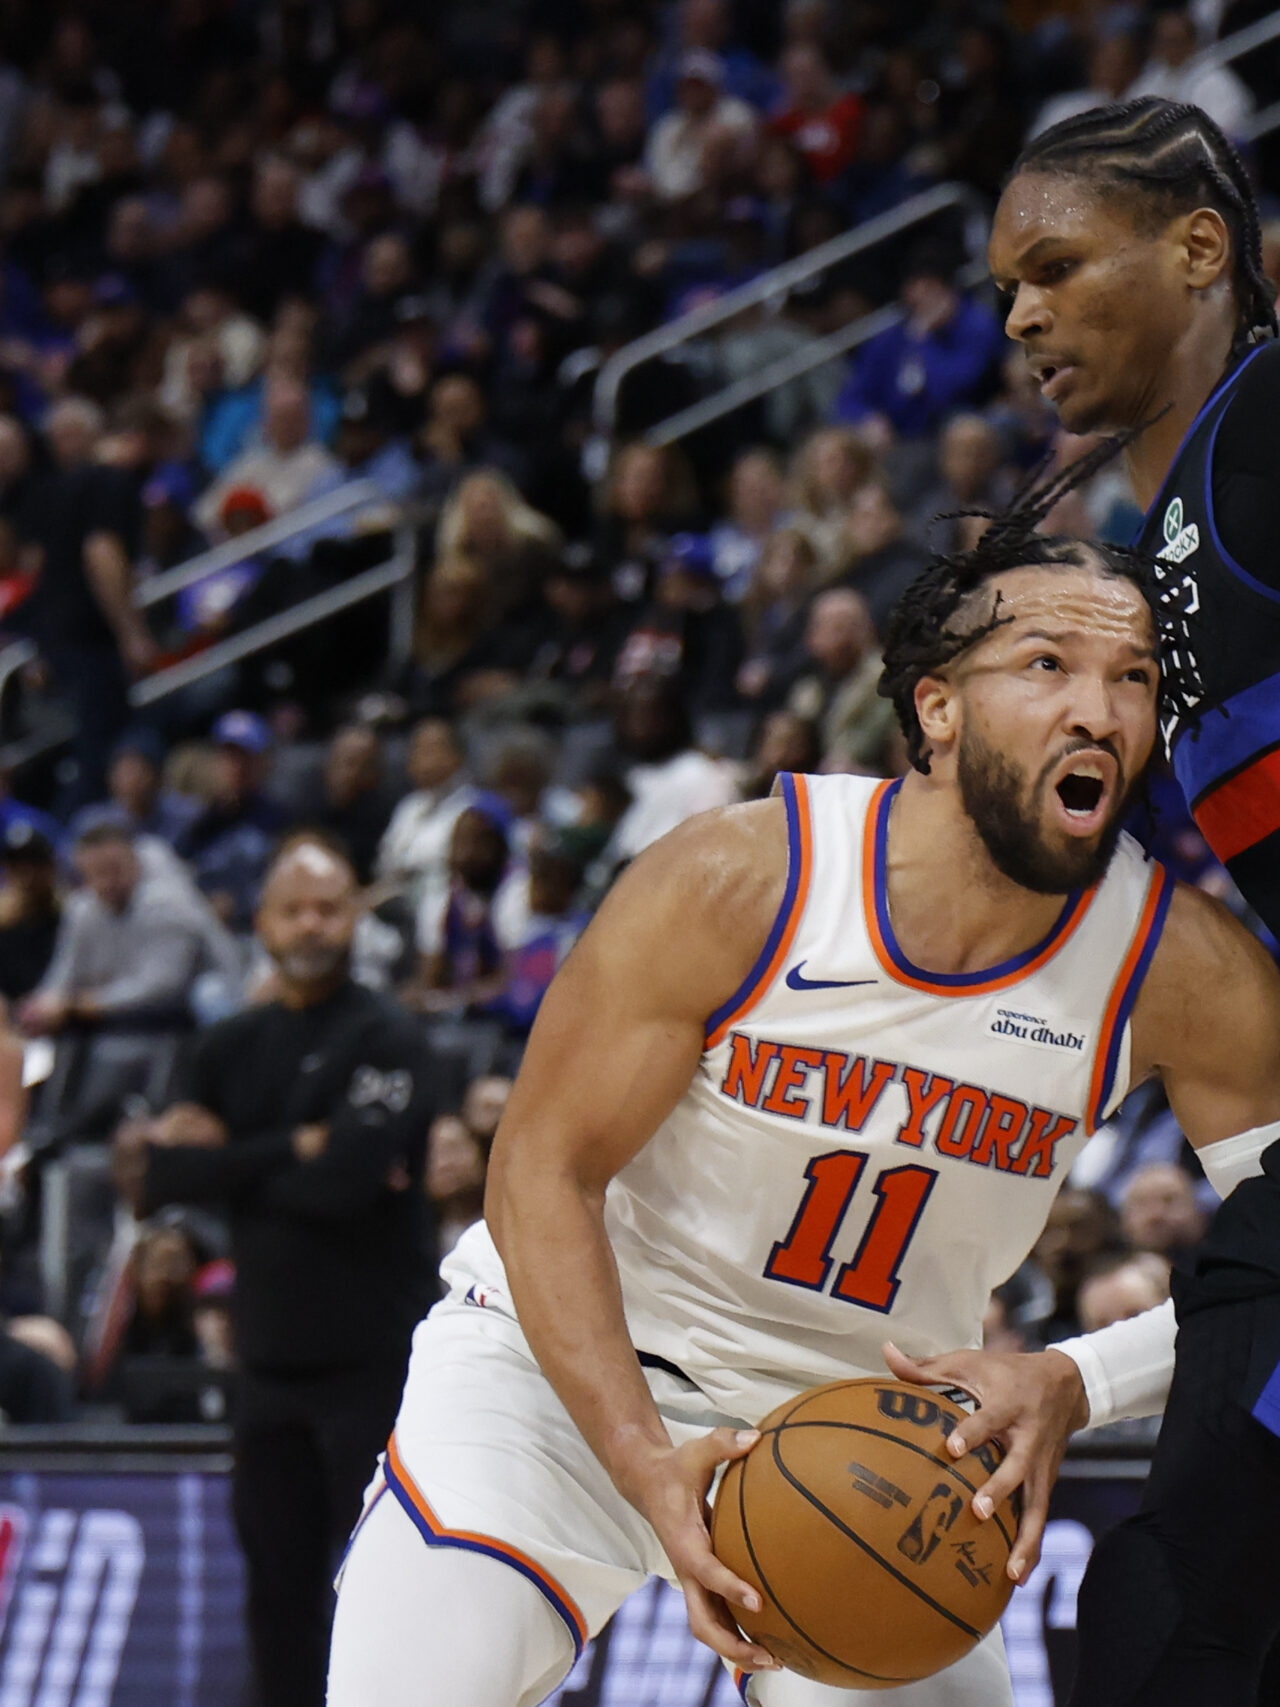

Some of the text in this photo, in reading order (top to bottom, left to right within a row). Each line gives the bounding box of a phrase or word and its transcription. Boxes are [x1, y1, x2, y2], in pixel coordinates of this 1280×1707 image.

[990, 1019, 1086, 1051] abu dhabi
[996, 1008, 1047, 1026] experience
[721, 1031, 1082, 1180] NEW YORK
[762, 1149, 940, 1315] 11
